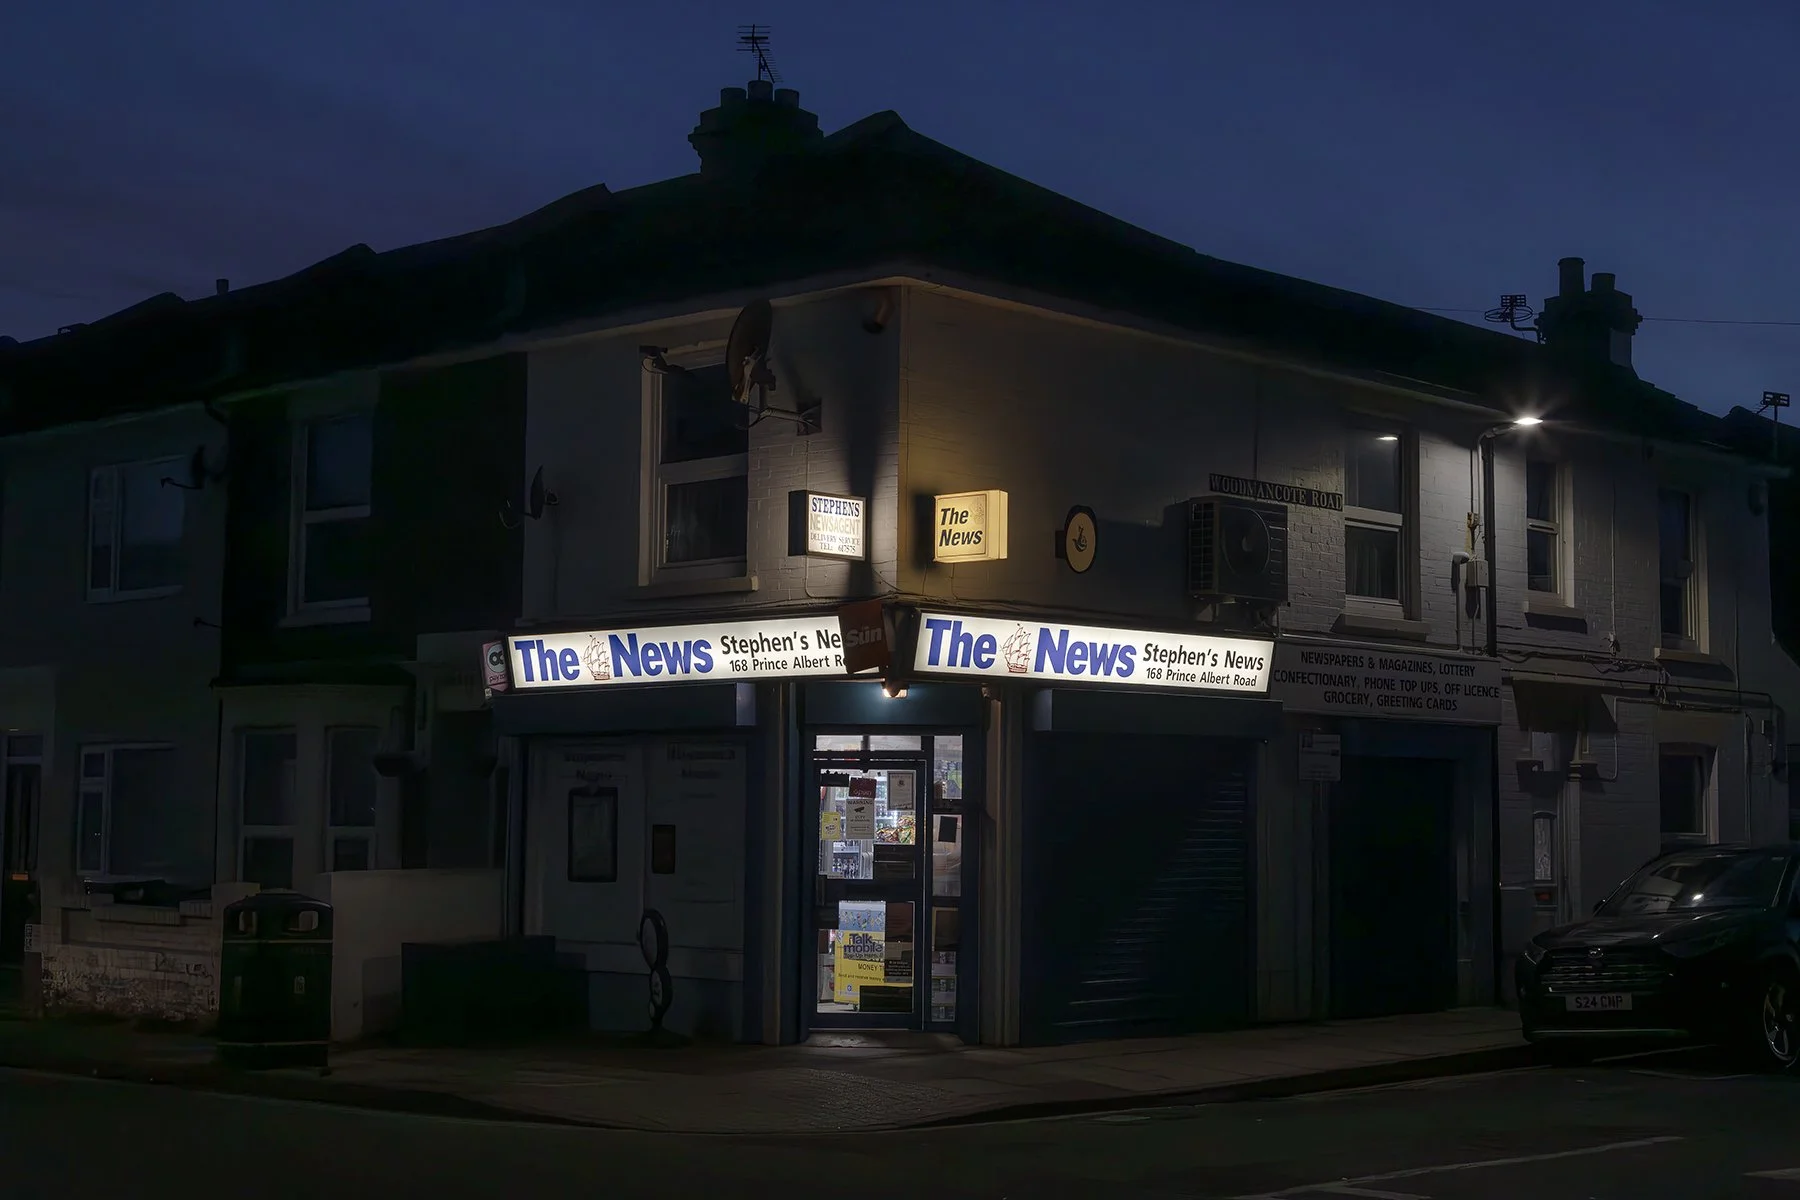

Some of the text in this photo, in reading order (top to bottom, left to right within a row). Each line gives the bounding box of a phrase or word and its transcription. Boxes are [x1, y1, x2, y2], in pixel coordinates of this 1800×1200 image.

[1211, 475, 1342, 510] WOODMANCOTE ROAD
[811, 497, 860, 517] STEPHENS
[940, 508, 968, 526] The
[810, 513, 861, 535] NEWSAGENT
[810, 532, 837, 543] DELIVERY
[939, 529, 983, 547] News
[720, 629, 841, 658] Stephen's Ne
[925, 618, 1136, 678] The News
[514, 633, 714, 682] The News
[730, 660, 748, 672] 168
[753, 658, 788, 671] Prince
[793, 655, 830, 669] Albert
[1143, 643, 1264, 671] Stephen's News
[1301, 651, 1475, 677] NEWSPAPERS & MAGAZINES, LOTTERY
[1146, 667, 1257, 686] 168 Prince Albert Road
[1364, 677, 1395, 690] PHONE
[1400, 679, 1417, 692] TOP
[1444, 683, 1460, 695] OFF
[1464, 685, 1499, 698] LICENCE
[1324, 691, 1458, 711] GROCERY, GREETING CARDS
[844, 942, 883, 953] mobile
[858, 963, 878, 971] MONEY
[1575, 996, 1598, 1008] S24
